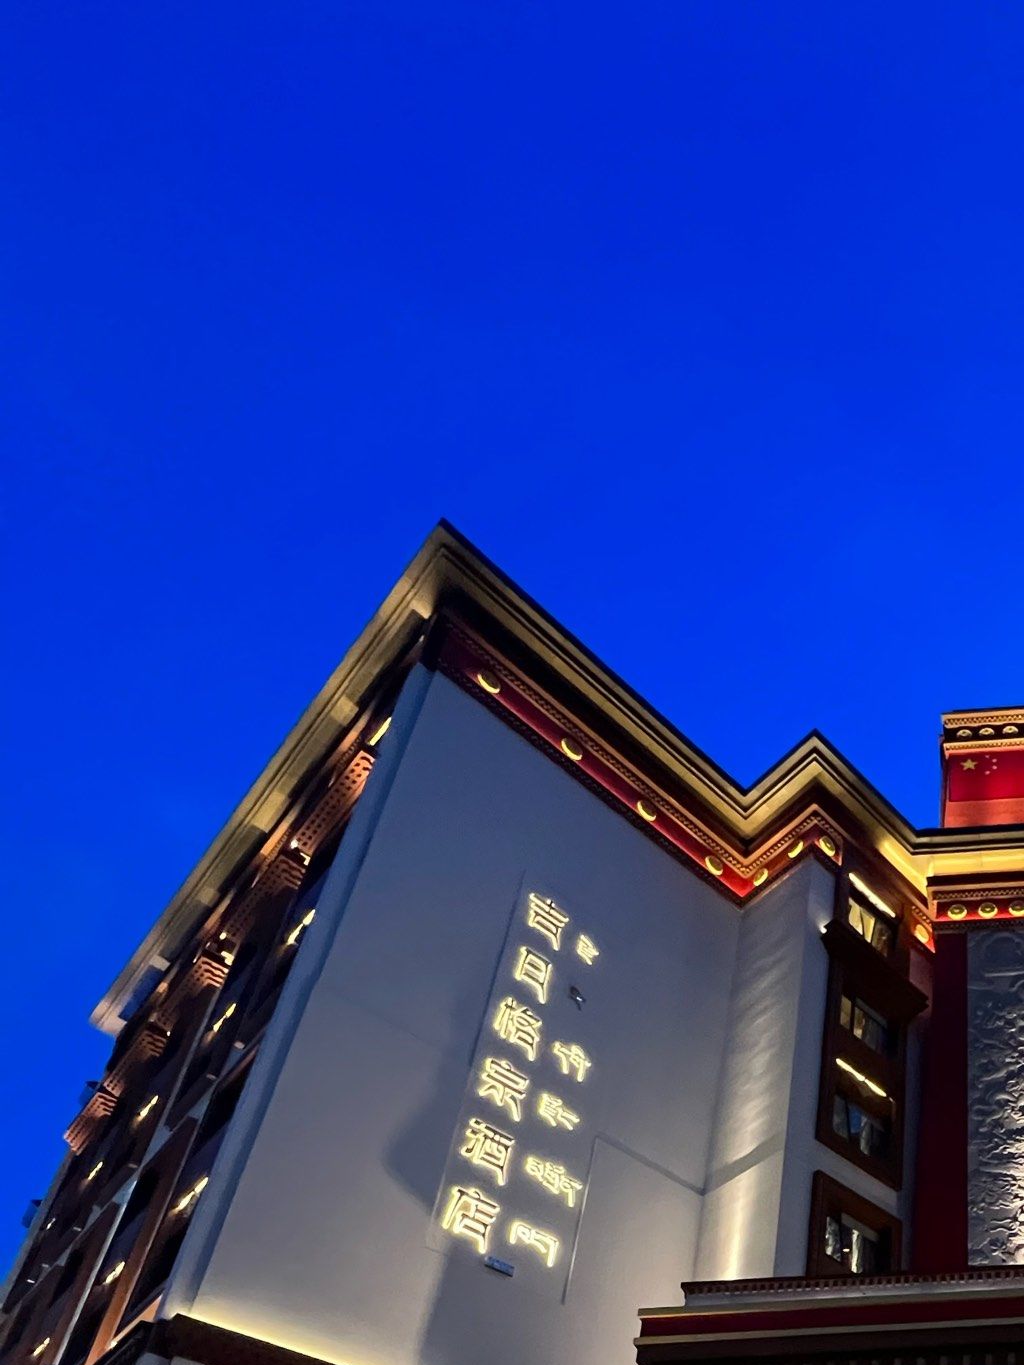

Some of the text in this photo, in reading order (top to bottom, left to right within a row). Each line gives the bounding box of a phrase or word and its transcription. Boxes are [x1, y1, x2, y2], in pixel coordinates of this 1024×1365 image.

[441, 892, 570, 1255] 吉日格宗酒店
